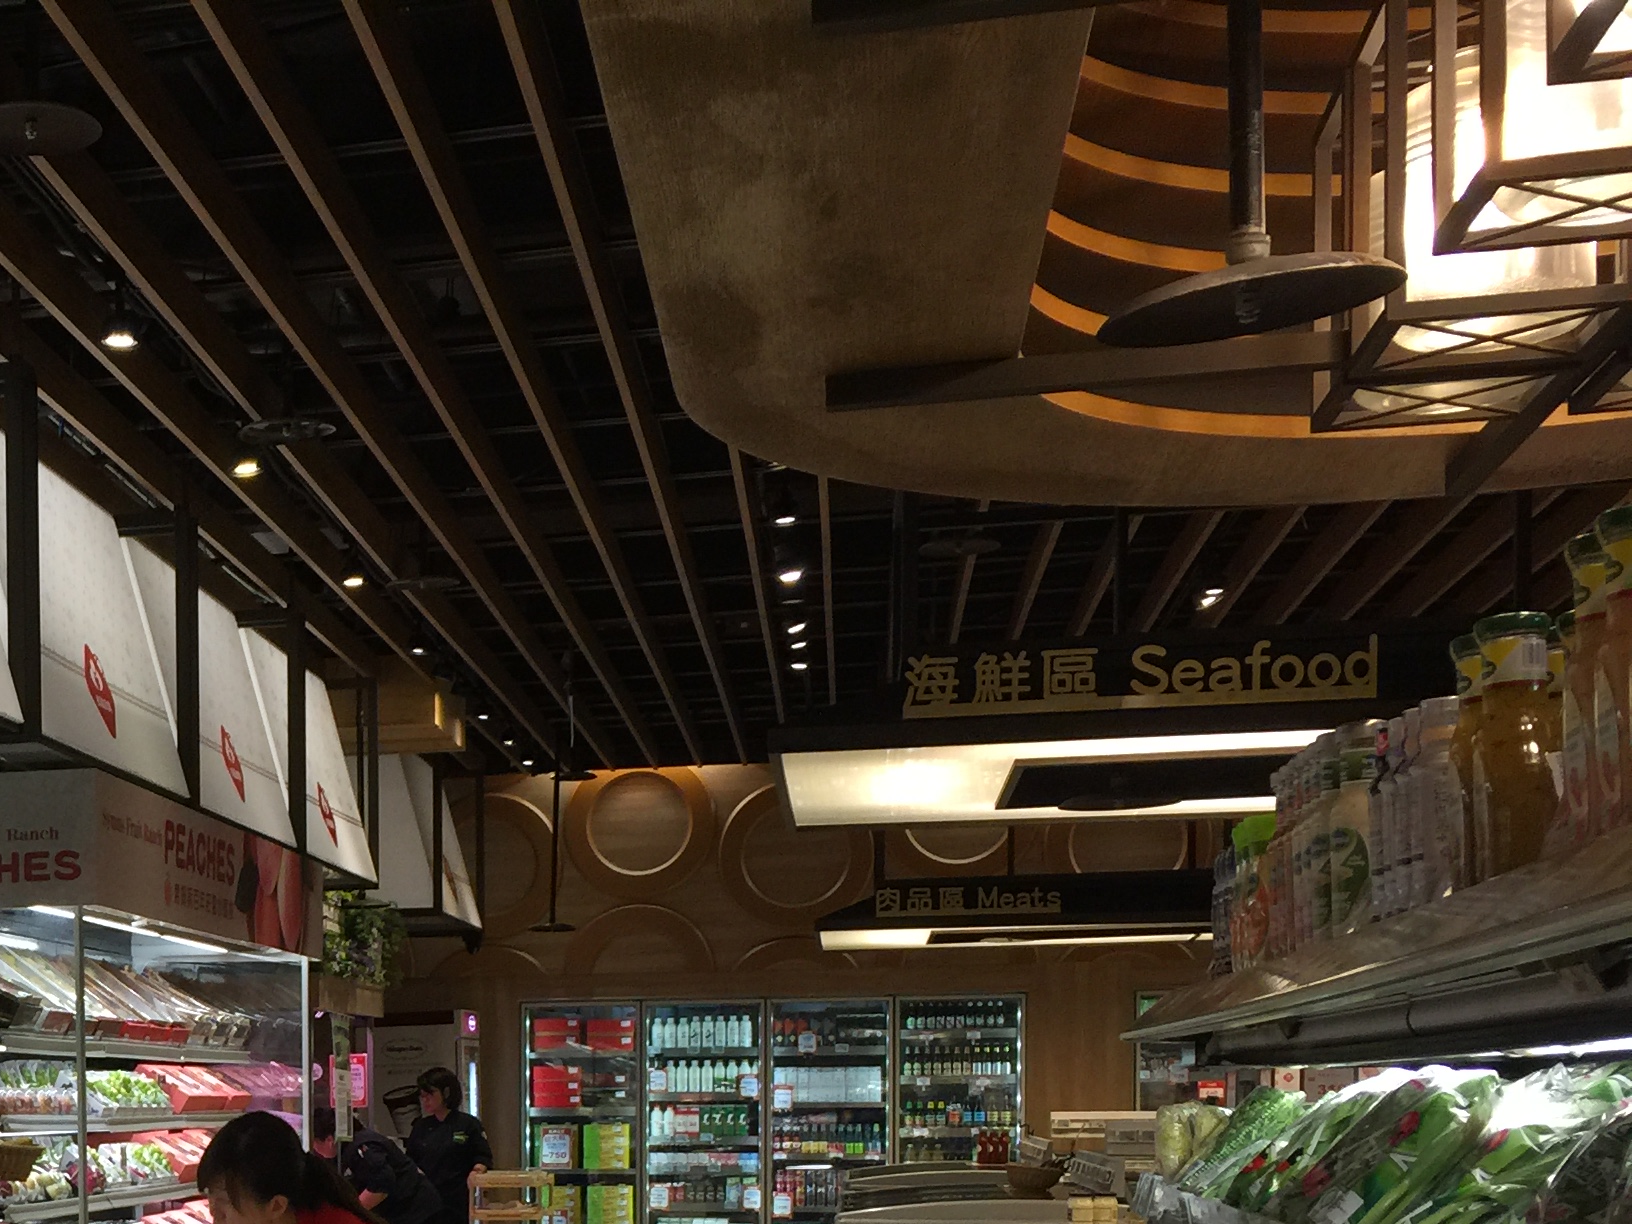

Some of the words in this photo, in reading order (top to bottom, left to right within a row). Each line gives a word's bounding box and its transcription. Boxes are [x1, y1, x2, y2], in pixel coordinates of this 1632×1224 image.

[903, 647, 1099, 704] 海鮮區
[1130, 633, 1377, 696] Seafood
[164, 819, 235, 886] PEACHES
[876, 886, 964, 912] 肉品區
[978, 886, 1061, 909] Meats
